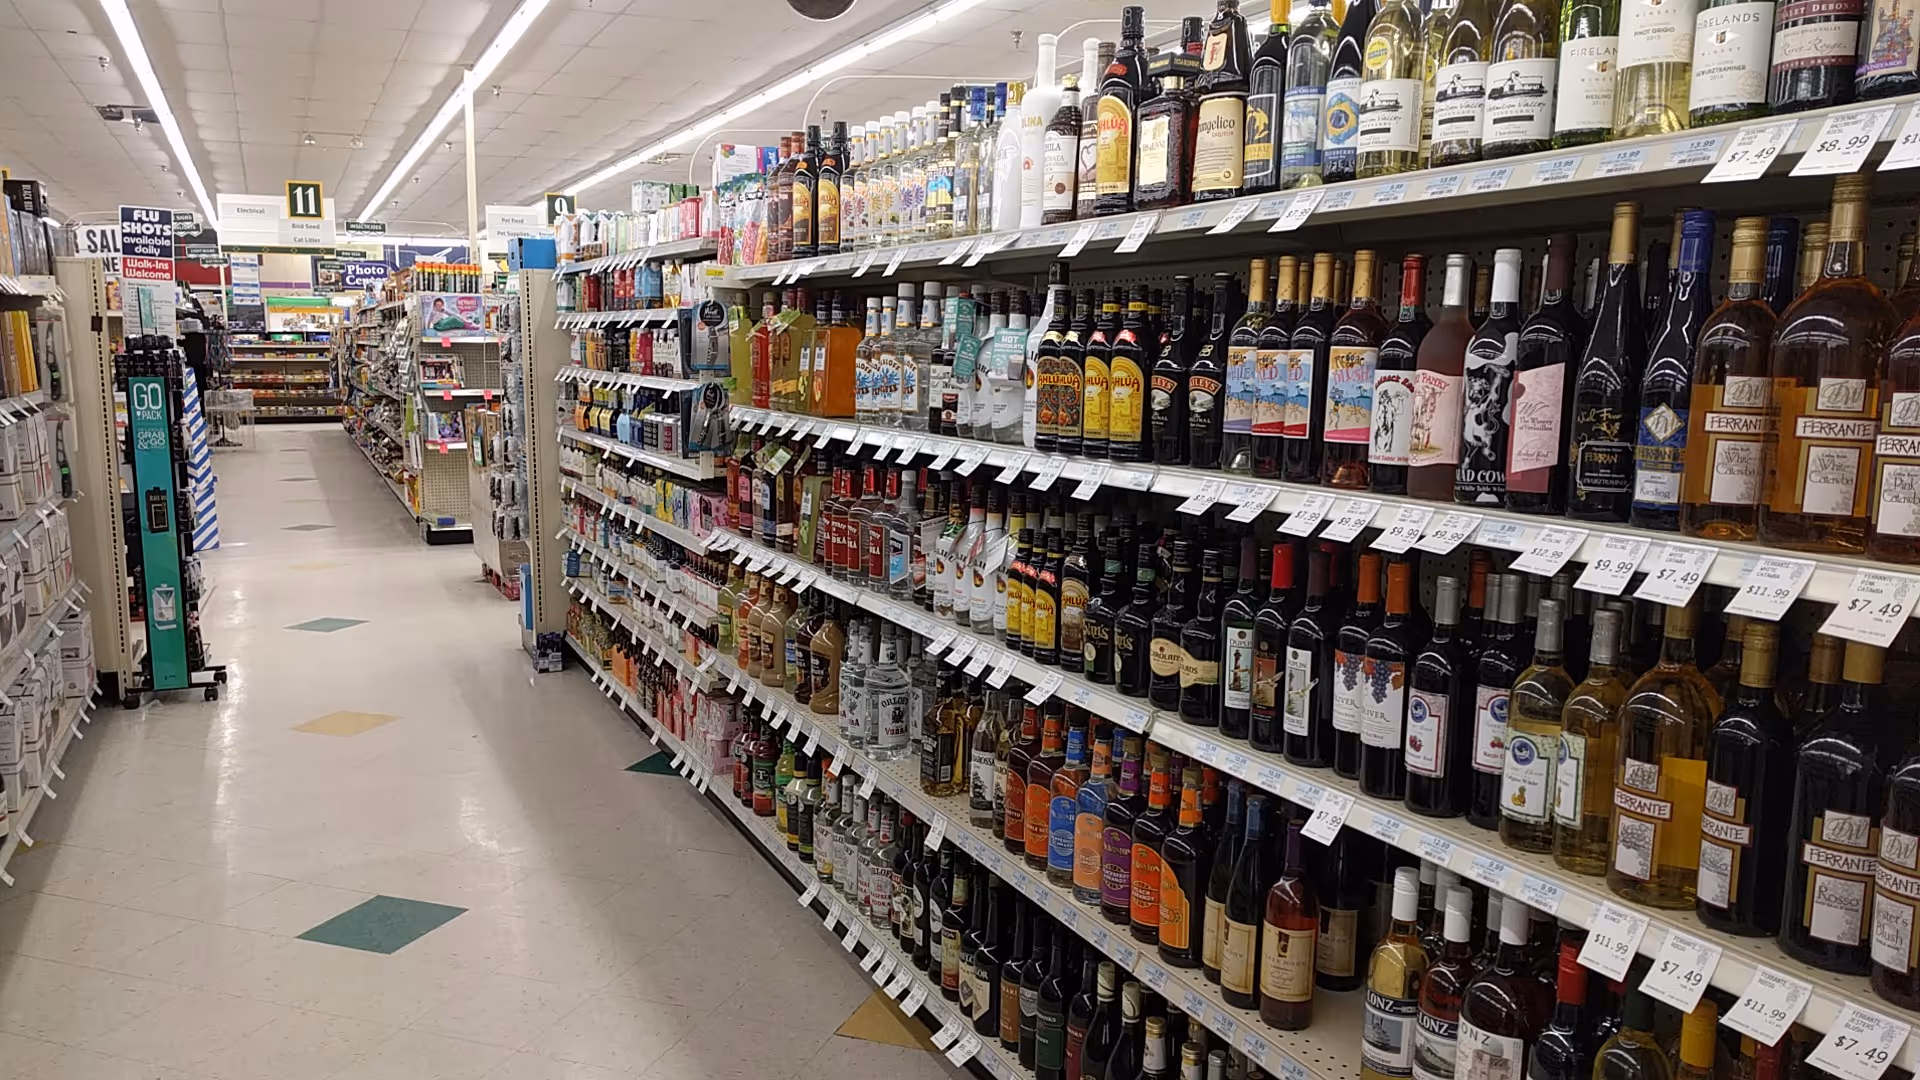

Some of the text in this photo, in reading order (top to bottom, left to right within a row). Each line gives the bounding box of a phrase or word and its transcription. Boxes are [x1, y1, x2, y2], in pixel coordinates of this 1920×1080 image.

[1570, 47, 1617, 57] FIRELAN
[1866, 61, 1903, 71] VINEYARDS
[1045, 142, 1061, 152] HILA
[1690, 139, 1716, 150] 13.99
[1816, 134, 1870, 154] $8.99
[1617, 150, 1640, 160] 13.99
[1727, 146, 1776, 164] $7.49
[1553, 160, 1574, 169] 13.99
[293, 185, 318, 215] 11
[133, 209, 160, 222] FLU
[236, 207, 266, 215] Electrical
[122, 221, 171, 236] SHOTS
[509, 230, 530, 238] Supplies
[86, 229, 120, 254] SAL
[123, 235, 172, 247] available
[134, 244, 161, 257] daily
[126, 259, 170, 271] Walk-Ins
[346, 264, 385, 276] Photo
[125, 268, 171, 280] Welcome
[1001, 335, 1018, 344] HOT
[1152, 376, 1174, 390] LEYS
[133, 383, 162, 410] GO
[142, 410, 162, 420] PACK
[1710, 416, 1765, 431] FERRANT
[1802, 420, 1872, 438] FERRANTE
[137, 431, 165, 439] GRAB
[149, 438, 166, 446] GO
[1723, 451, 1753, 465] White
[1818, 458, 1849, 472] White
[1809, 469, 1854, 486] Catawba
[1893, 477, 1915, 491] Pink
[1640, 486, 1671, 500] Riesling
[1294, 510, 1320, 522] $7.99
[1338, 517, 1366, 528] $9.99
[1390, 526, 1420, 540] $9.99
[1431, 529, 1465, 542] $9.99
[1530, 547, 1564, 560] $12.99
[1594, 559, 1633, 574] $9.99
[1656, 567, 1699, 585] $7.49
[1860, 579, 1876, 587] PINK
[1746, 584, 1790, 600] $11.99
[1848, 597, 1903, 618] $7.49
[1335, 695, 1361, 710] LIVER
[885, 726, 908, 736] VODKA
[1615, 790, 1668, 817] FERRANTE
[1316, 810, 1342, 829] $7.99
[1488, 861, 1505, 872] 9.99
[1809, 848, 1878, 872] FERRANTE
[1540, 883, 1558, 895] 9.99
[1817, 886, 1860, 907] Rosso
[1876, 921, 1903, 947] Blush
[1593, 932, 1629, 955] $11.99
[1659, 959, 1704, 987] $7.49
[1743, 997, 1787, 1022] $11.99
[1833, 1033, 1890, 1065] $7.49
